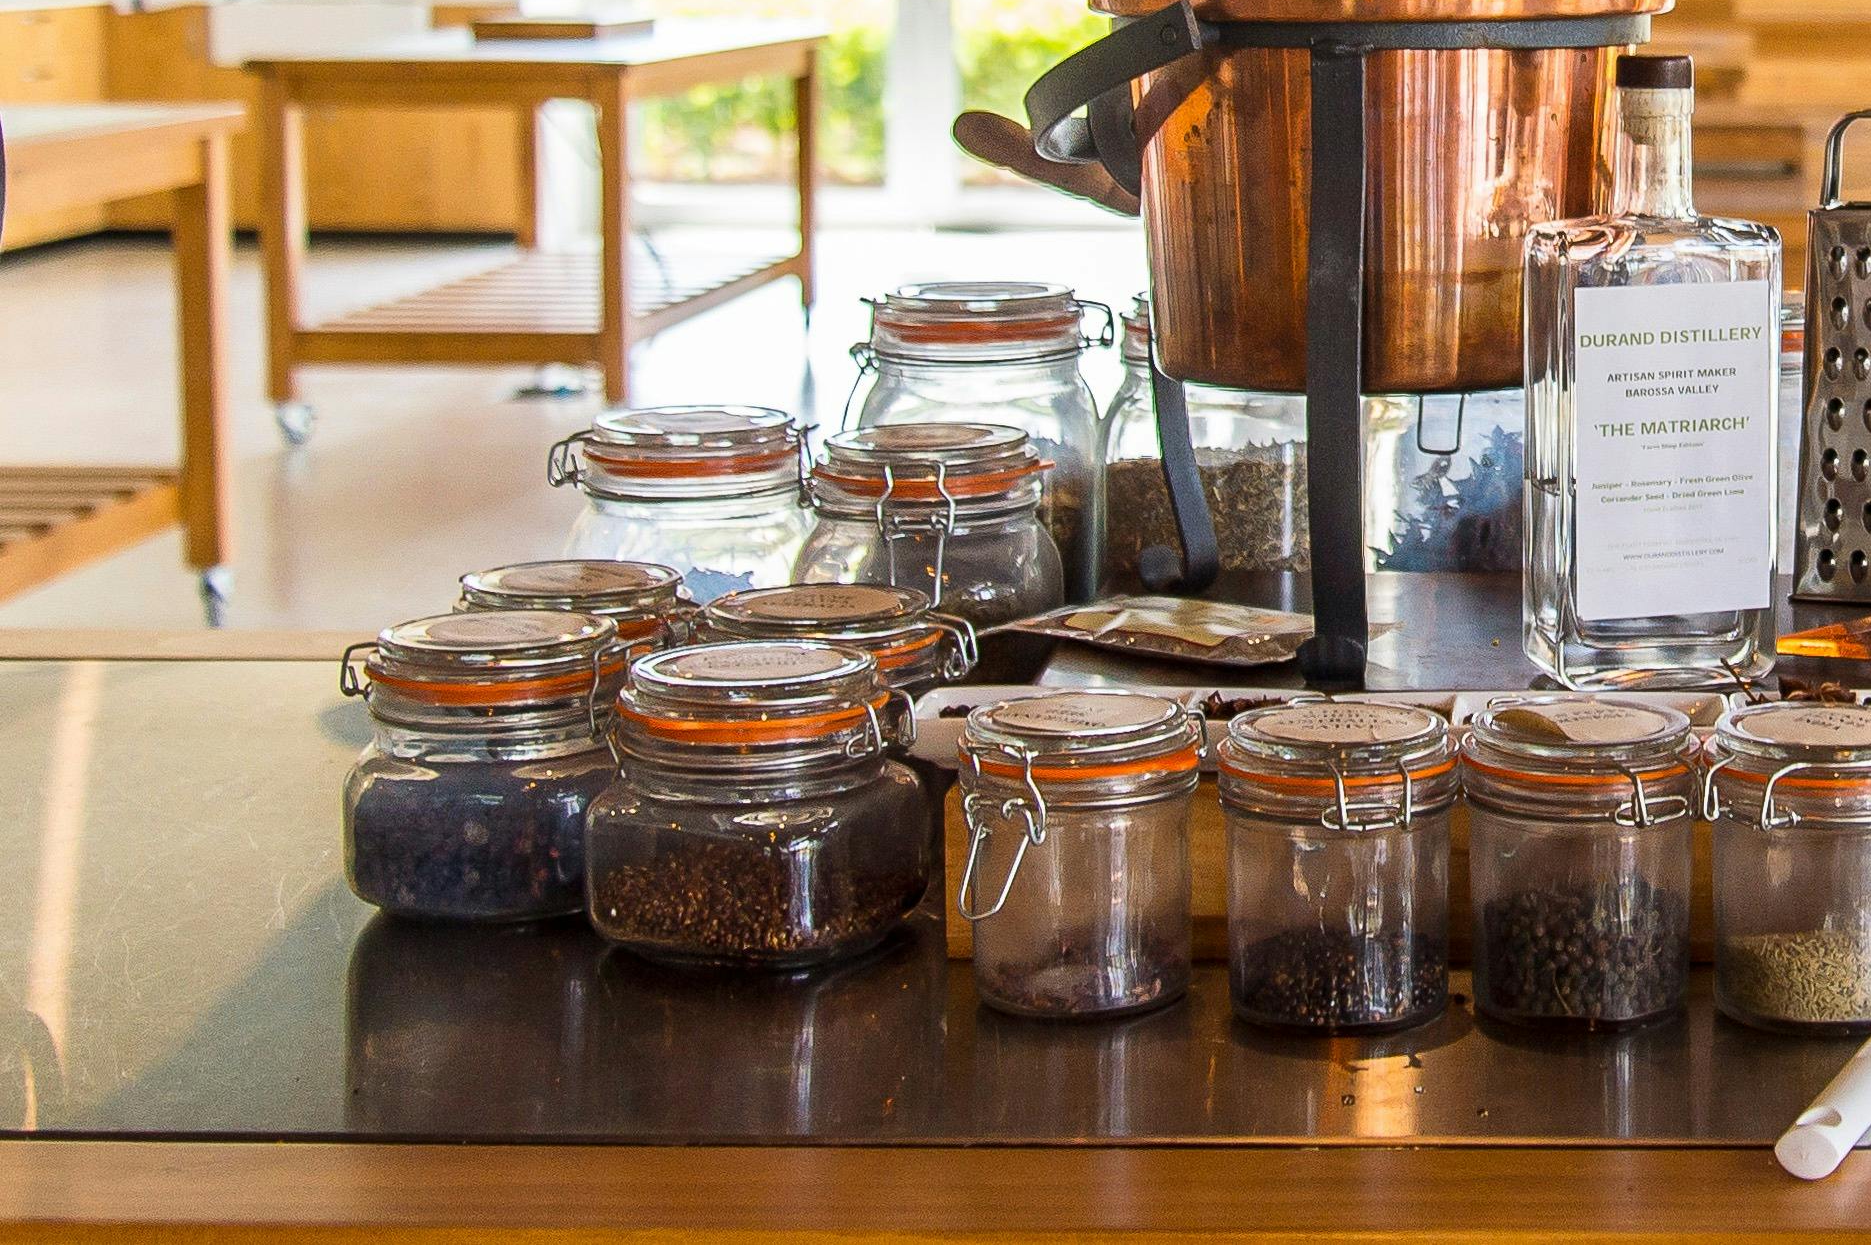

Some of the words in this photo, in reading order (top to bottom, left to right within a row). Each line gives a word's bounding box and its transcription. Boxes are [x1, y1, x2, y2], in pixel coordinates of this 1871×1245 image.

[1579, 331, 1655, 349] DURAND
[1660, 325, 1762, 345] DISTILLERY
[1607, 370, 1655, 383] ARTISAN
[1658, 368, 1694, 381] SPIRIT
[1697, 367, 1737, 378] MAKER
[1625, 386, 1675, 399] BAROSSA
[1677, 384, 1719, 396] VALLEY
[1594, 422, 1635, 438] 'THE
[1640, 415, 1750, 436] MATRIARCH'
[1591, 481, 1622, 491] Juniper
[1630, 479, 1672, 489] Rosemary
[1679, 476, 1704, 486] Fresh
[1705, 474, 1731, 484] Green
[1600, 494, 1642, 504] Coriander
[1671, 490, 1695, 500] Dried
[1697, 489, 1723, 499] Green
